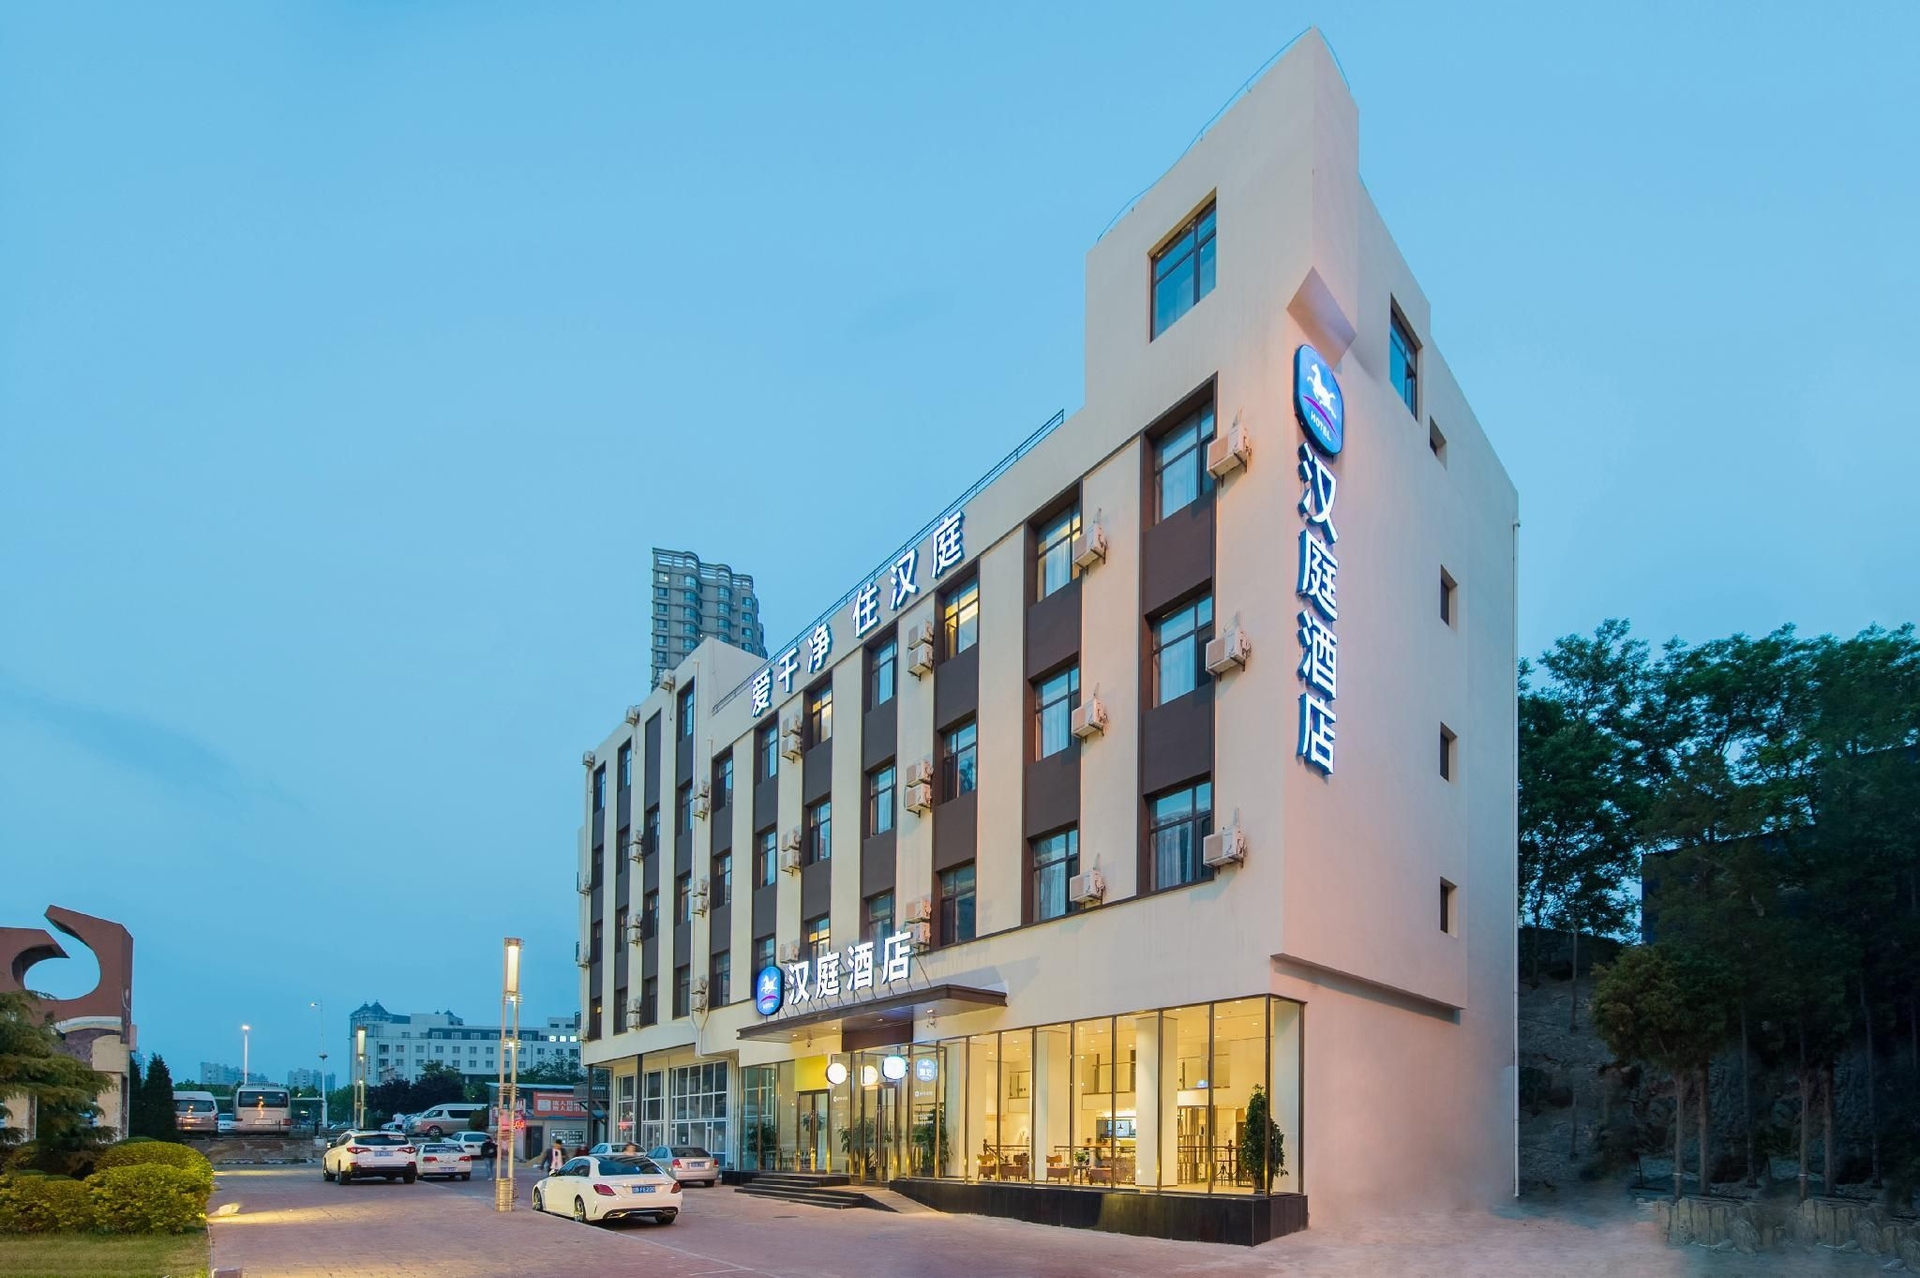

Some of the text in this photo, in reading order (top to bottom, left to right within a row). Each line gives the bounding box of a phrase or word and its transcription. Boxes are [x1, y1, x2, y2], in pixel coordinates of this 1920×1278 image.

[1310, 410, 1332, 442] HOTEL
[751, 511, 965, 717] 爱干净 住汉庭
[1299, 443, 1339, 775] 汉庭酒店
[788, 931, 912, 1005] 汉庭酒店
